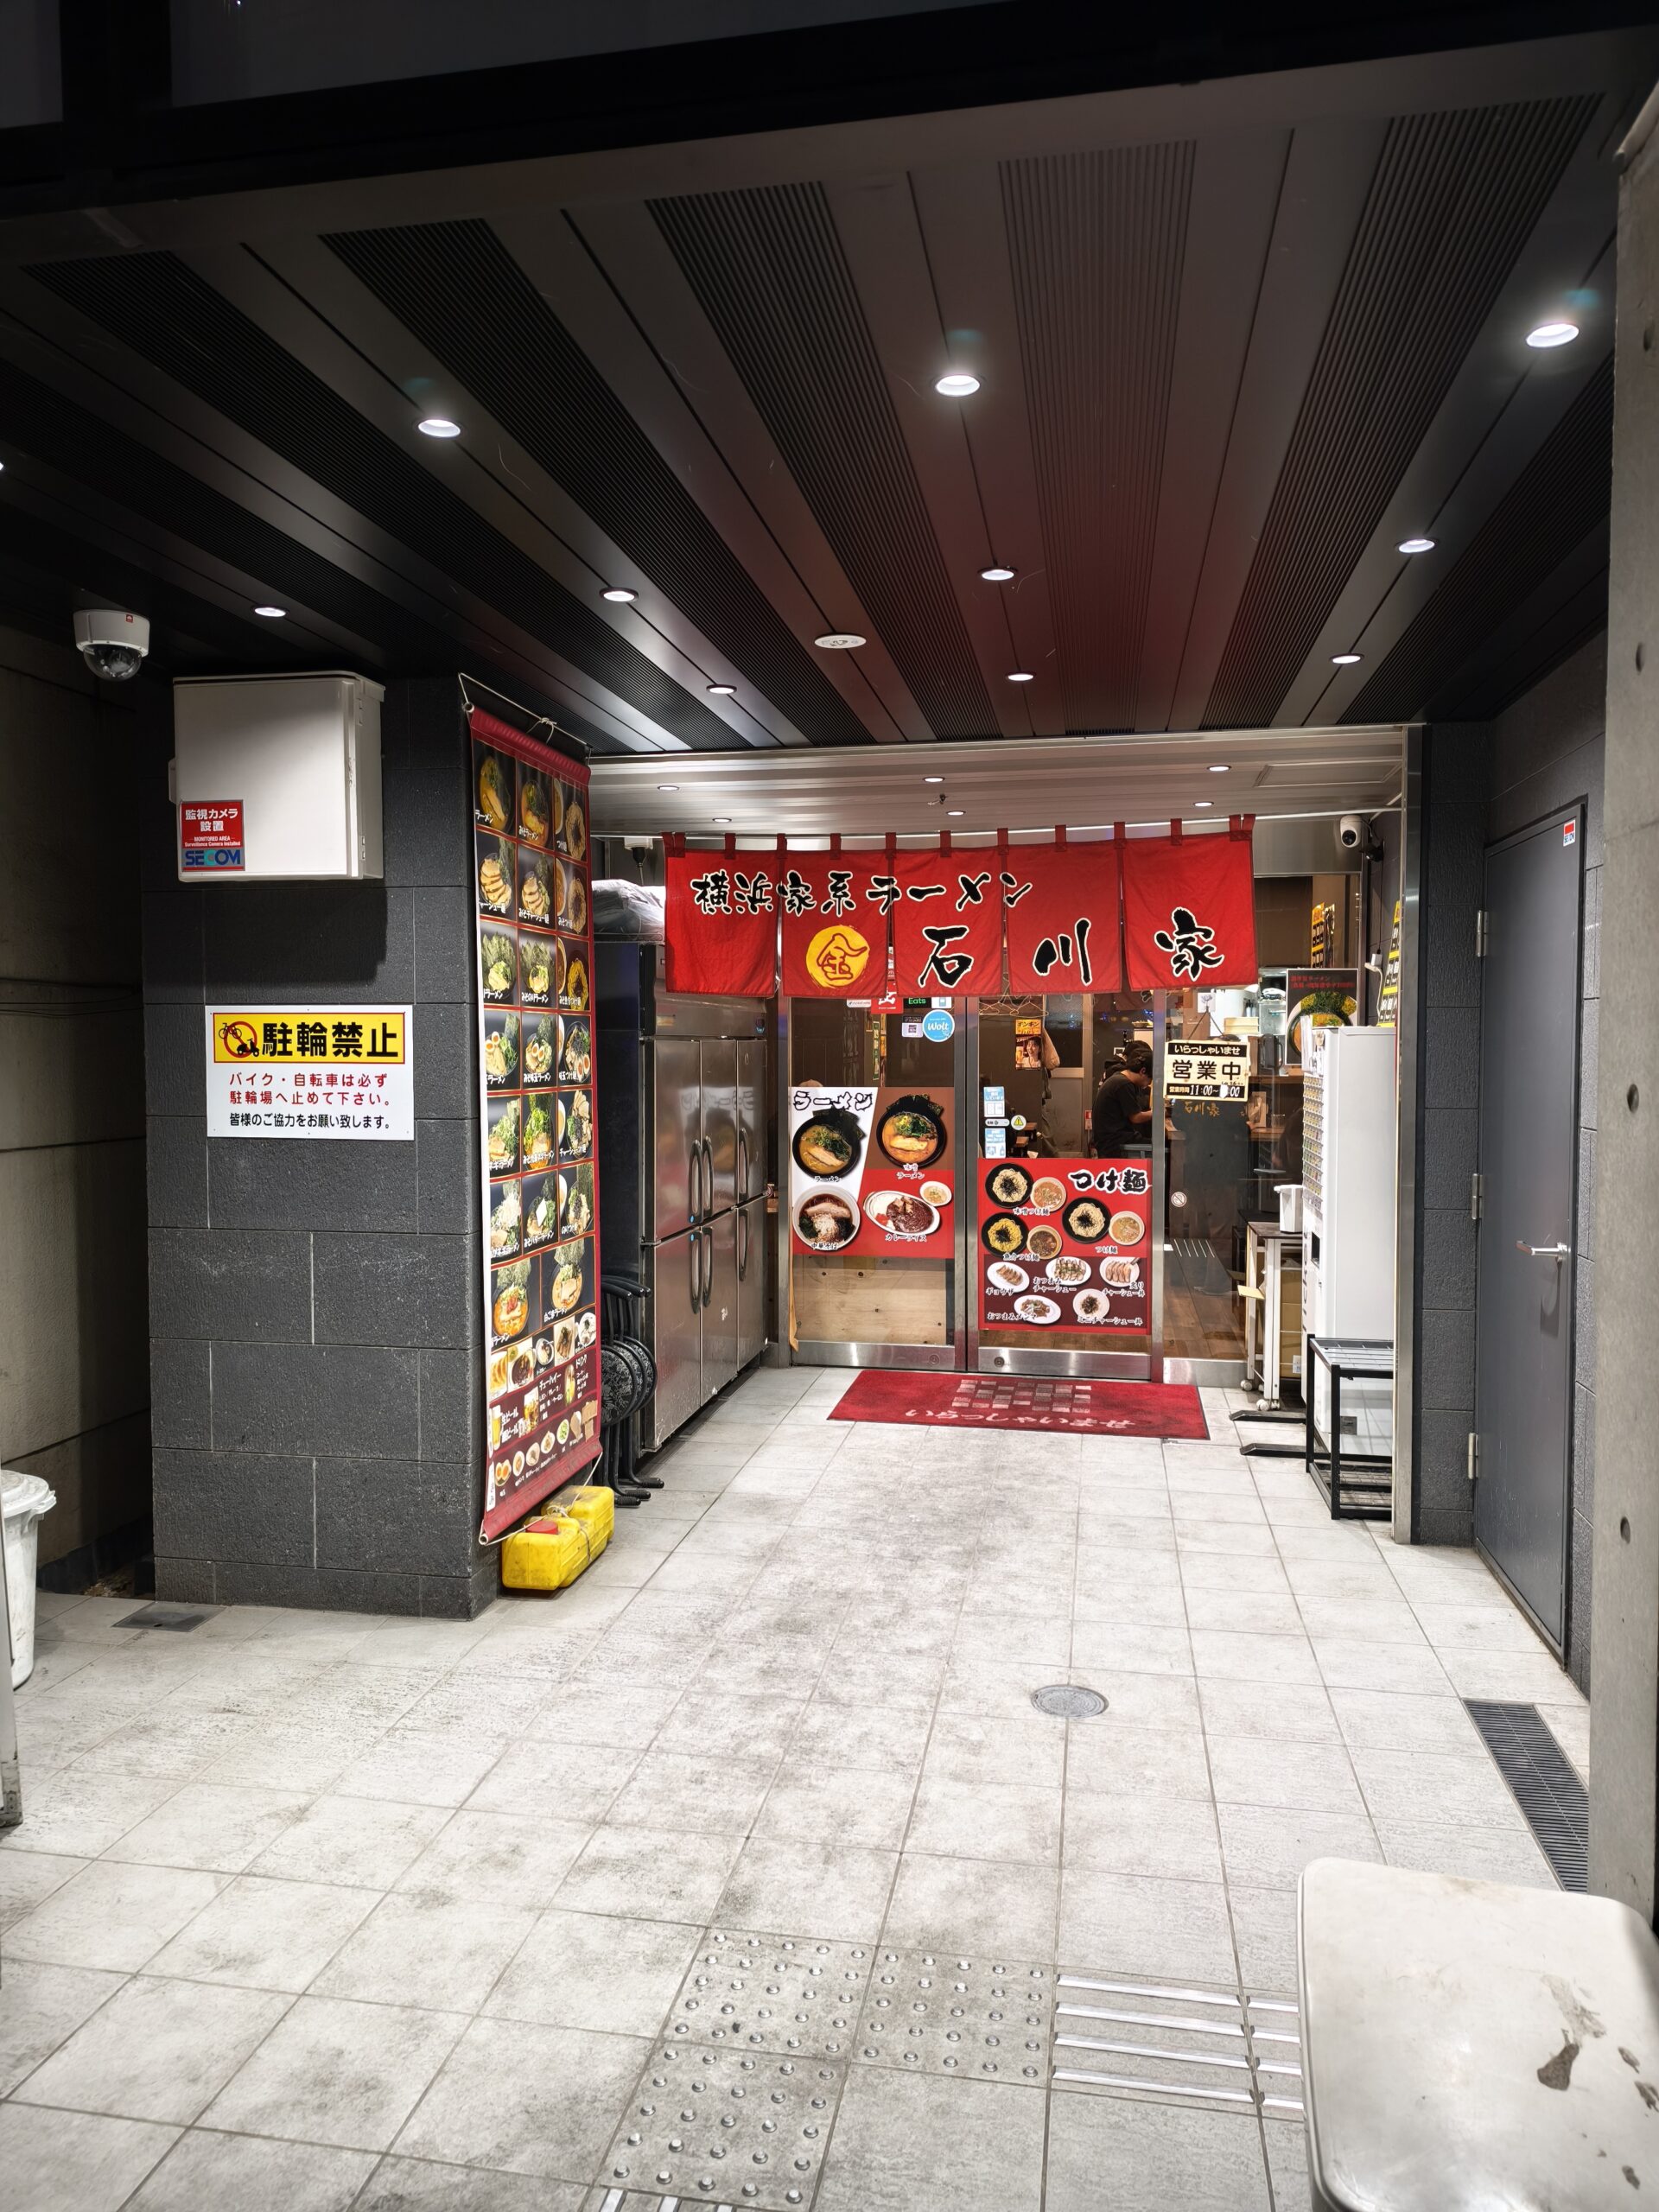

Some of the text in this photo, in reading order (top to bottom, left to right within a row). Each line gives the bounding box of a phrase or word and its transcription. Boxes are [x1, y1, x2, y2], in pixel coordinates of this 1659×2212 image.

[185, 808, 238, 820] 監視カメラ
[200, 820, 225, 832] 設置
[185, 849, 241, 867] SECOM
[690, 868, 1033, 916] 横浜家系ラーメン
[916, 905, 1225, 988] 石川家
[927, 1021, 950, 1031] Wolt
[261, 1021, 399, 1058] 駐輪禁止
[1174, 1044, 1241, 1055] いらっしゃいませ
[1172, 1059, 1242, 1081] 営業中
[229, 1072, 388, 1088] バイク・自転車は必ず
[229, 1090, 390, 1106] 駐輪場へ止めて下さい。
[793, 1090, 873, 1112] ラーメン
[229, 1112, 391, 1129] 皆様のご協力をお願い致します。
[896, 1171, 925, 1180] ラーメン
[1068, 1166, 1149, 1195] つけ麺
[885, 1233, 927, 1243] カレーライス
[1095, 1245, 1118, 1255] つけ麺
[1033, 1275, 1062, 1285] おつまみ
[985, 1287, 1014, 1296] ギョウザ
[1032, 1284, 1077, 1294] チャーシュー
[905, 1408, 1138, 1429] いらっしゃいませ
